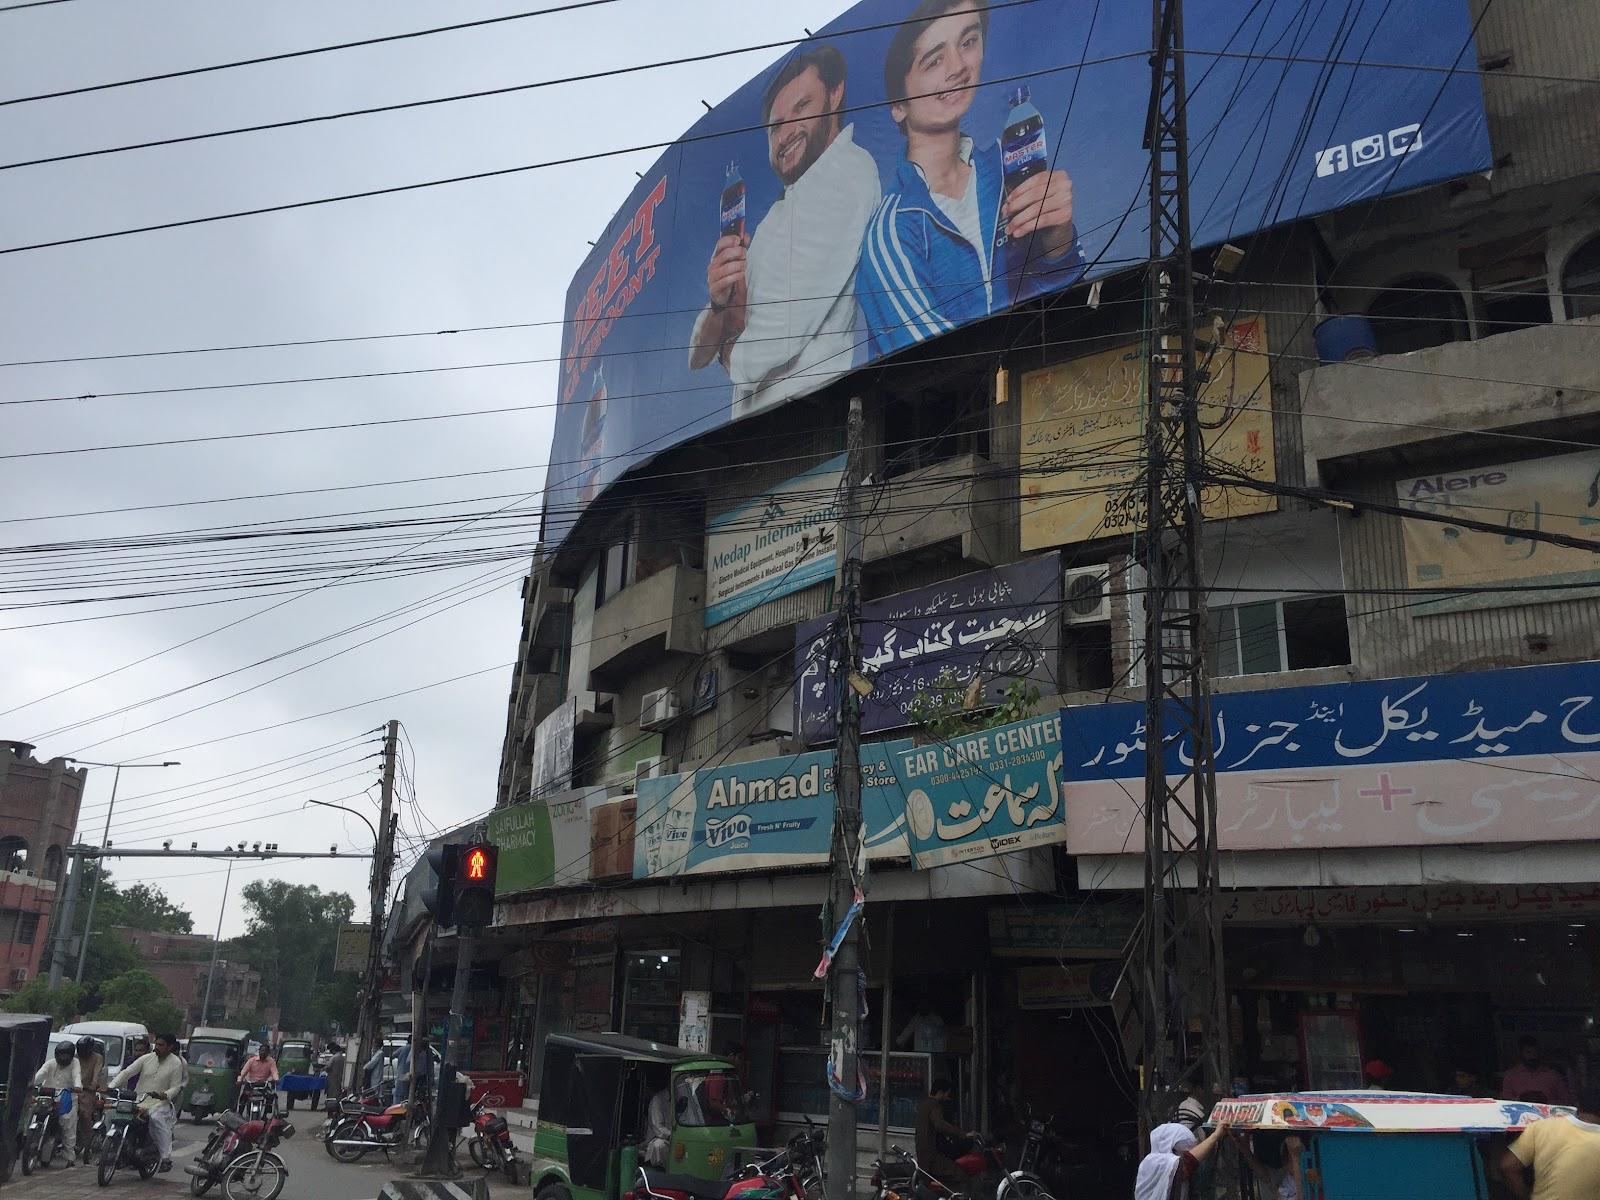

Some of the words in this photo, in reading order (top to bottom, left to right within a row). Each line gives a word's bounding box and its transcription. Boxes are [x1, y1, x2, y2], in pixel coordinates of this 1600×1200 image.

[1004, 141, 1044, 163] MASTER
[1408, 471, 1508, 498] Alere
[712, 543, 751, 572] Medap
[899, 620, 956, 668] کتاب
[905, 750, 939, 778] EAR
[943, 737, 991, 769] CARE
[705, 764, 820, 810] Ahmad
[878, 760, 887, 772] &
[866, 776, 897, 788] Store
[936, 773, 1045, 842] سماعت
[495, 811, 535, 835] SAIFULLAH
[496, 829, 537, 853] PHARMACY
[990, 835, 1022, 850] WIDEX
